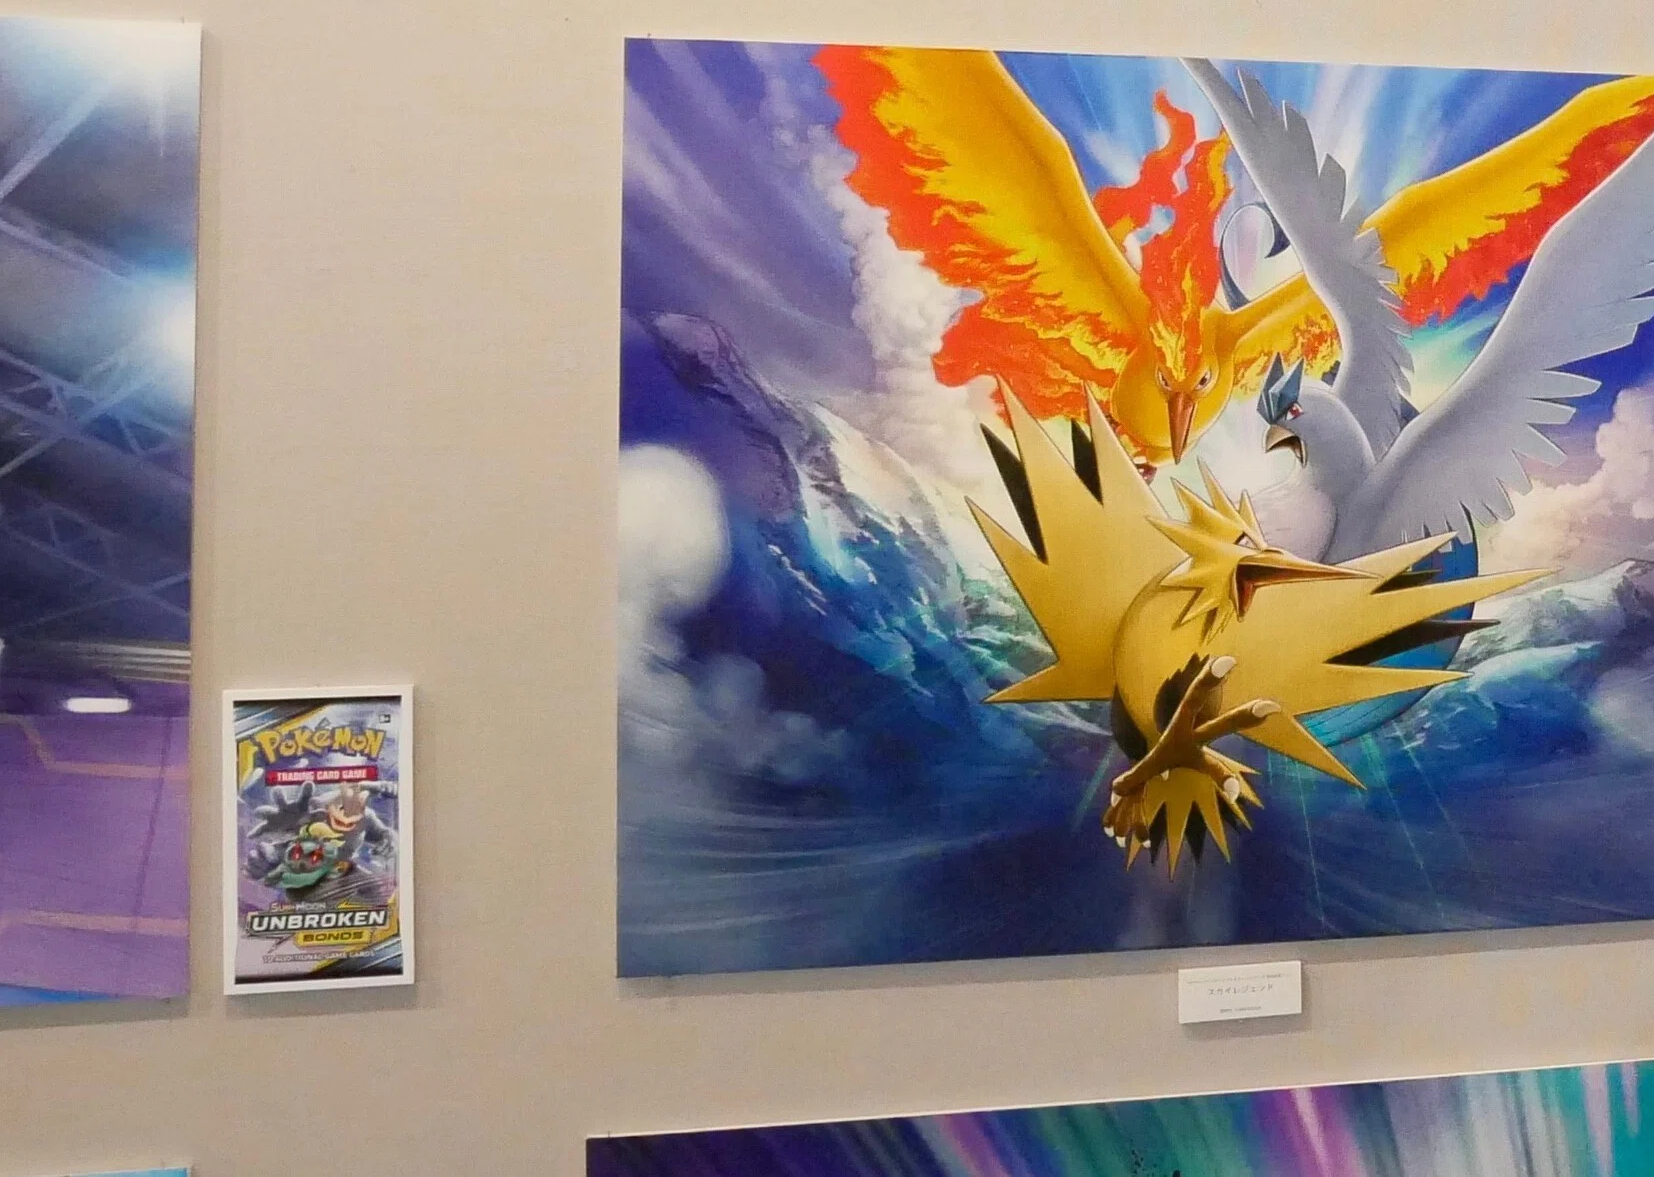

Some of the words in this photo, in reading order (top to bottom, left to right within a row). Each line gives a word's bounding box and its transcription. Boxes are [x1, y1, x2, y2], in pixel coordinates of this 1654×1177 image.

[277, 772, 314, 782] TRADING
[316, 770, 340, 780] CARD
[342, 768, 367, 779] GAME
[252, 910, 385, 931] UNBROKEN
[302, 931, 364, 941] BONDS
